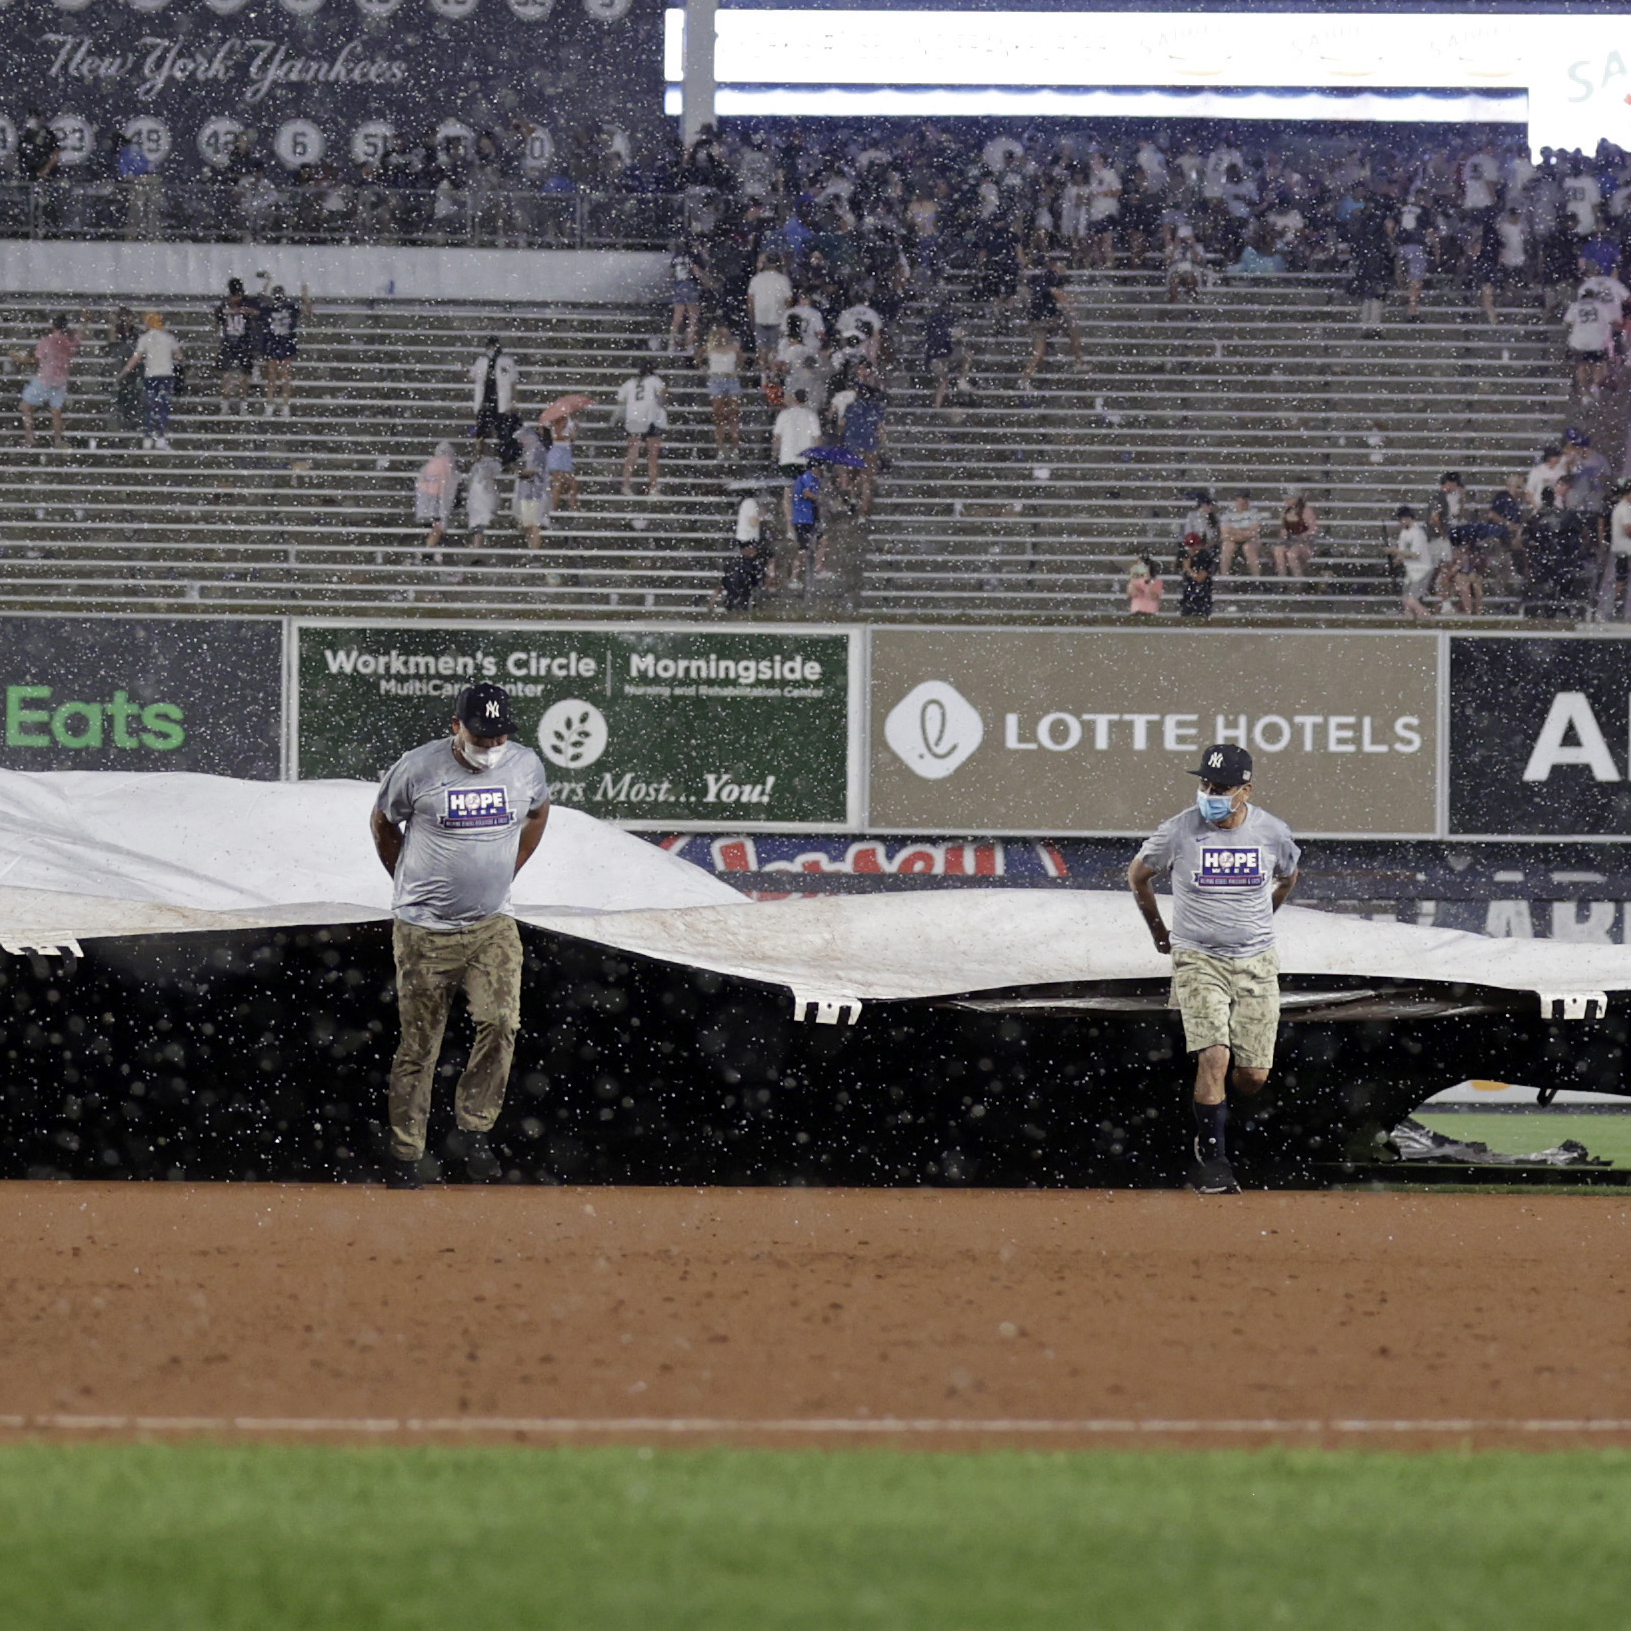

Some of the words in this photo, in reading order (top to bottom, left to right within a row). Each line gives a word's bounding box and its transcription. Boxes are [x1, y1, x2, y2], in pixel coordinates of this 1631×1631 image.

[41, 33, 133, 77] New
[138, 33, 237, 101] York
[245, 39, 404, 102] Yankees
[291, 132, 307, 157] 6
[325, 650, 495, 677] Workmen's
[507, 651, 597, 678] Circle
[629, 654, 822, 683] Morningside
[4, 683, 186, 750] Eats
[485, 700, 500, 718] NY
[1005, 711, 1199, 753] LOTTE
[1215, 713, 1421, 755] HOTELS
[1208, 751, 1224, 768] NY
[450, 791, 503, 810] HOPE
[700, 773, 775, 804] You!
[1204, 851, 1257, 868] HOPE
